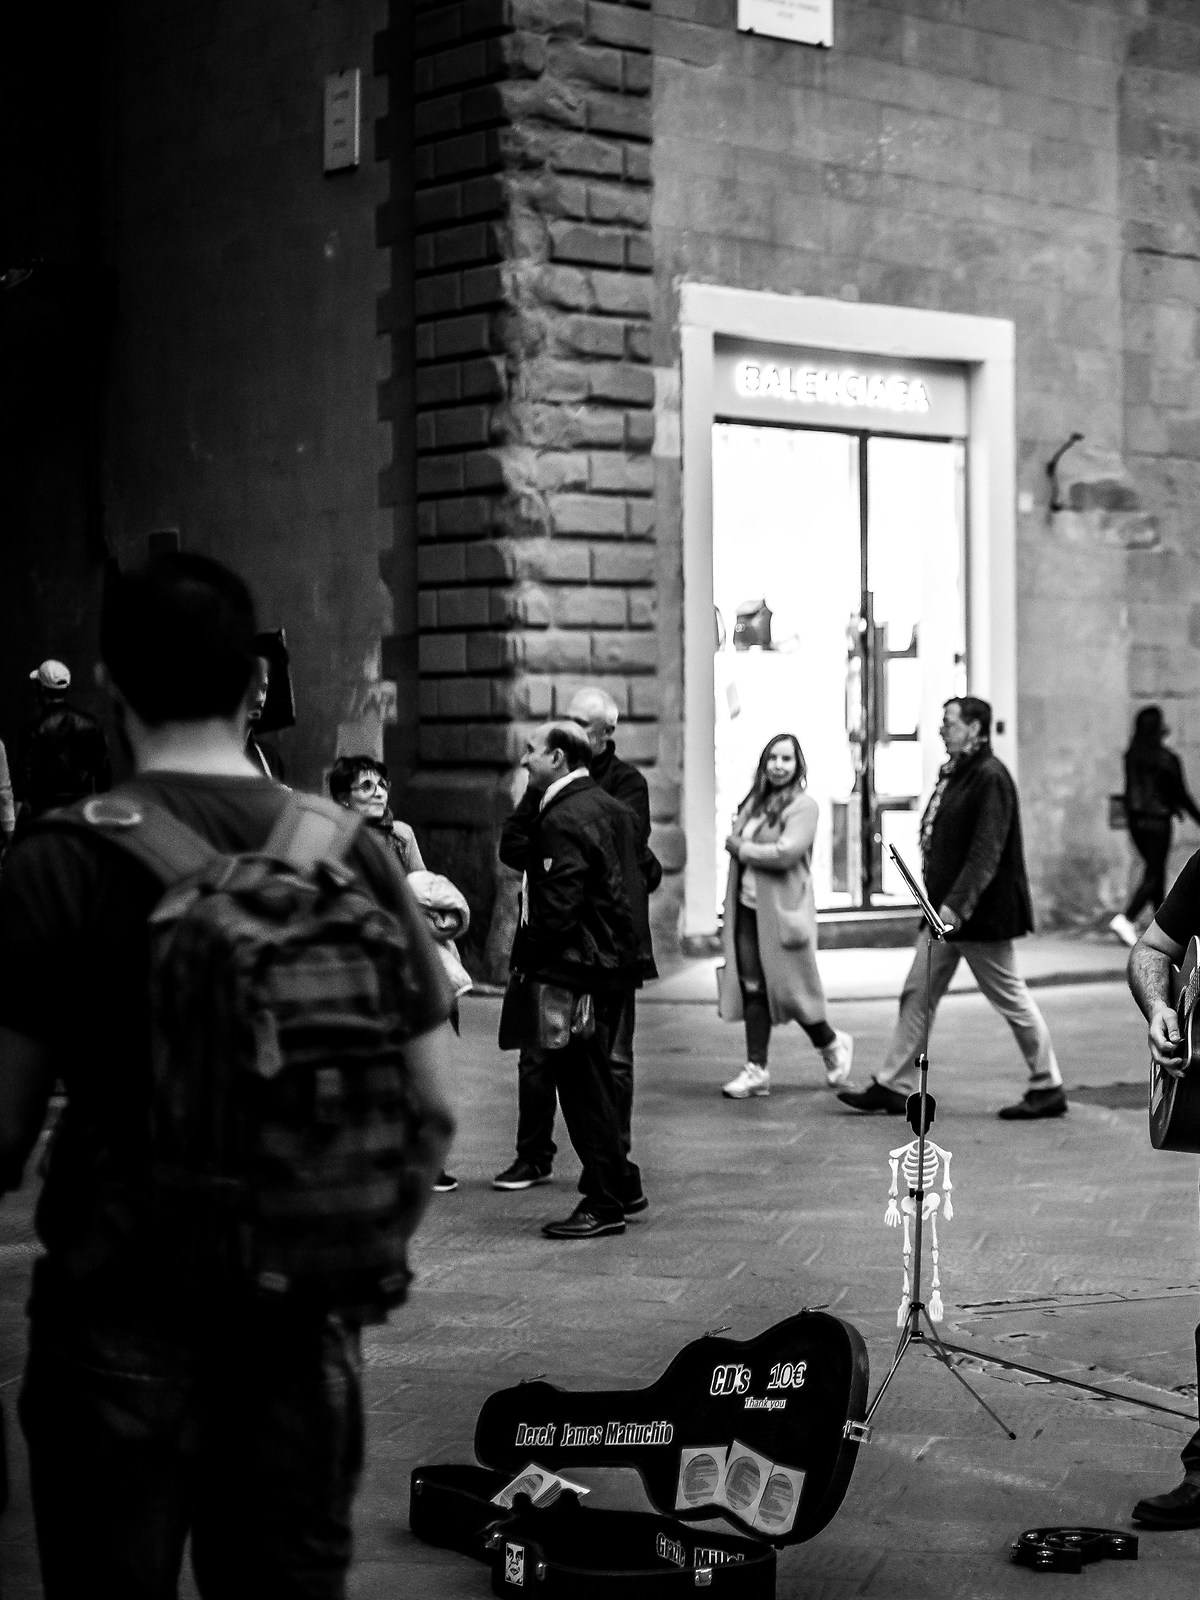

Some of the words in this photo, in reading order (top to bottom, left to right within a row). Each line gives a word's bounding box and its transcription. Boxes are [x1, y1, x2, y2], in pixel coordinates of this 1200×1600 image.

[737, 361, 931, 412] BALENCIAGA
[710, 1364, 752, 1396] CD's
[767, 1360, 807, 1389] 10€
[744, 1396, 768, 1409] Thank
[768, 1399, 787, 1411] you
[515, 1423, 556, 1447] Derek
[560, 1423, 603, 1446] James
[604, 1420, 674, 1446] Mattuchio
